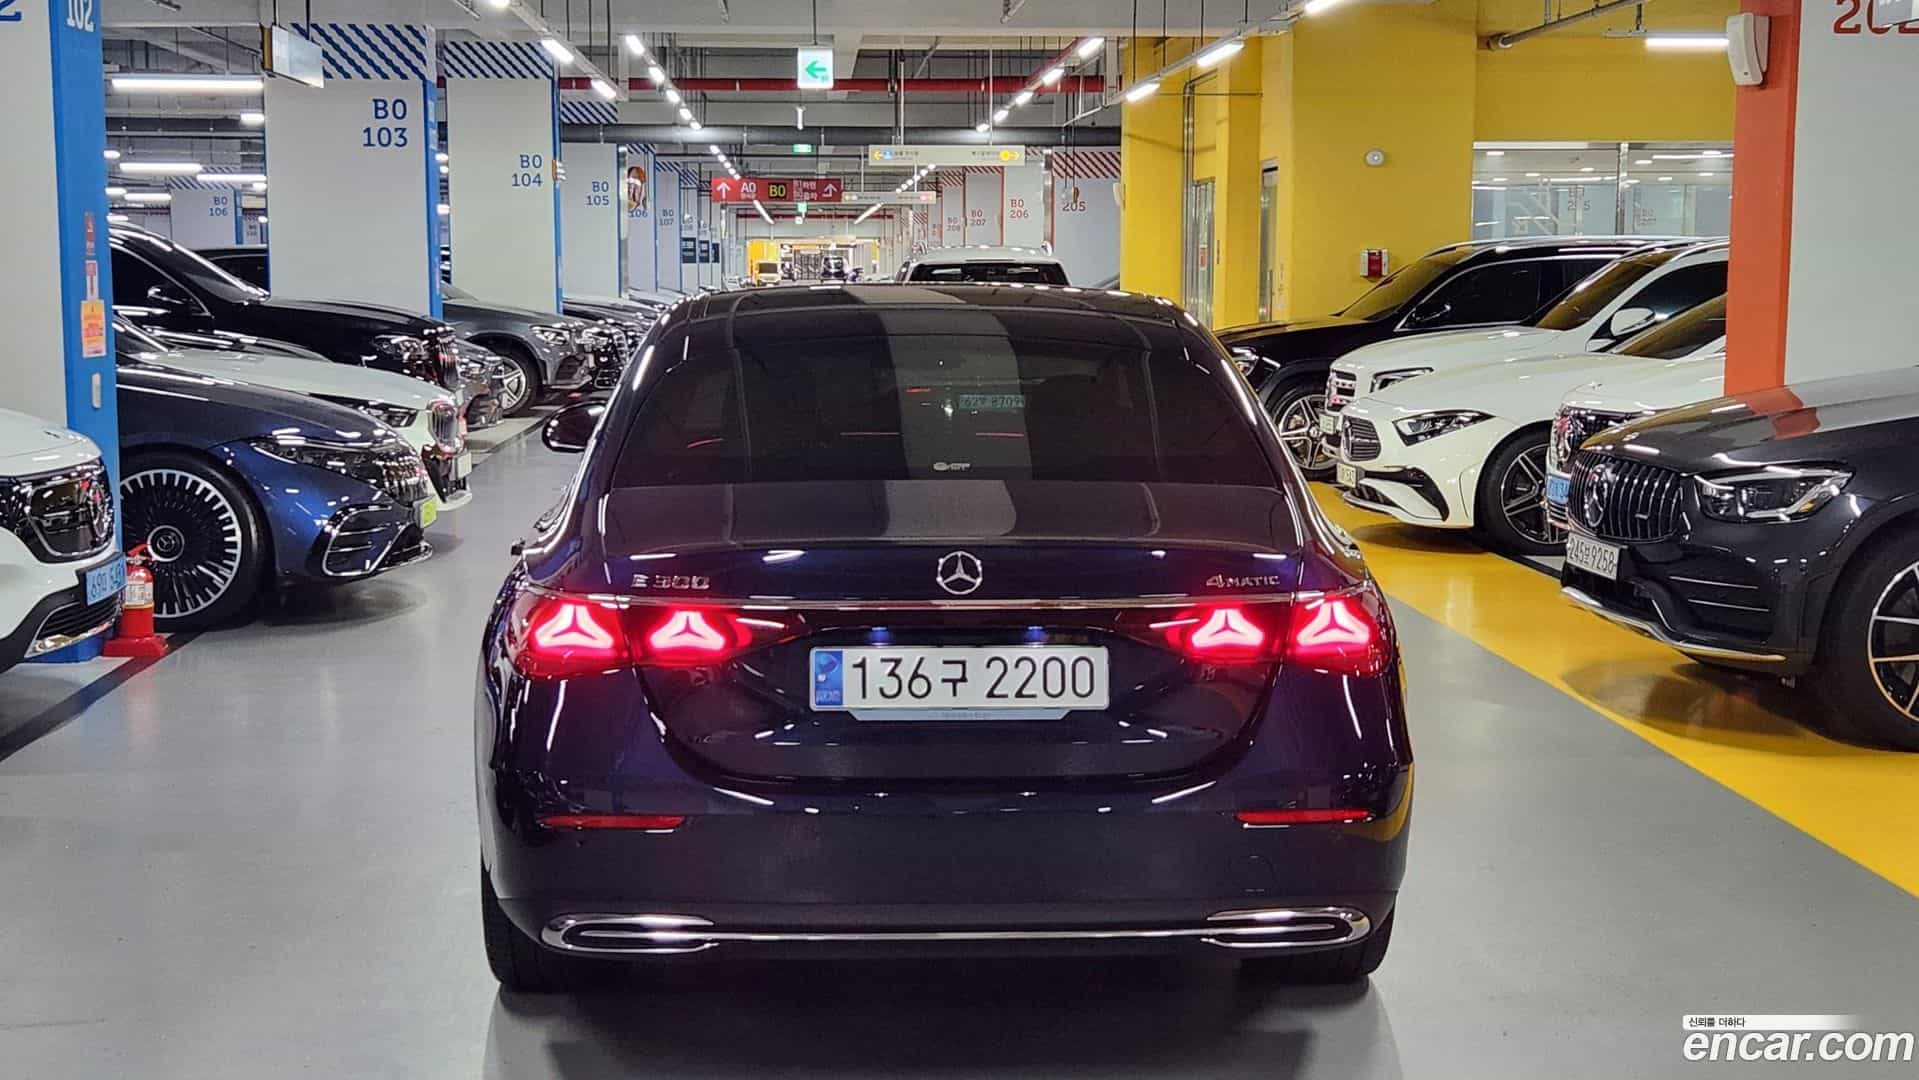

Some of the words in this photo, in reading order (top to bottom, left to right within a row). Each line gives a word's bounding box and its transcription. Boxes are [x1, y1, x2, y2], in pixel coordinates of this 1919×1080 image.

[1833, 0, 1919, 35] 20
[362, 126, 408, 148] 103
[511, 172, 543, 187] 104
[585, 195, 610, 206] 105
[1062, 200, 1087, 212] 205
[1009, 209, 1030, 219] 206
[630, 573, 649, 588] E
[653, 574, 711, 590] 300
[1205, 573, 1281, 589] 4MATIC
[851, 656, 969, 700] 136구
[985, 655, 1095, 700] 2200
